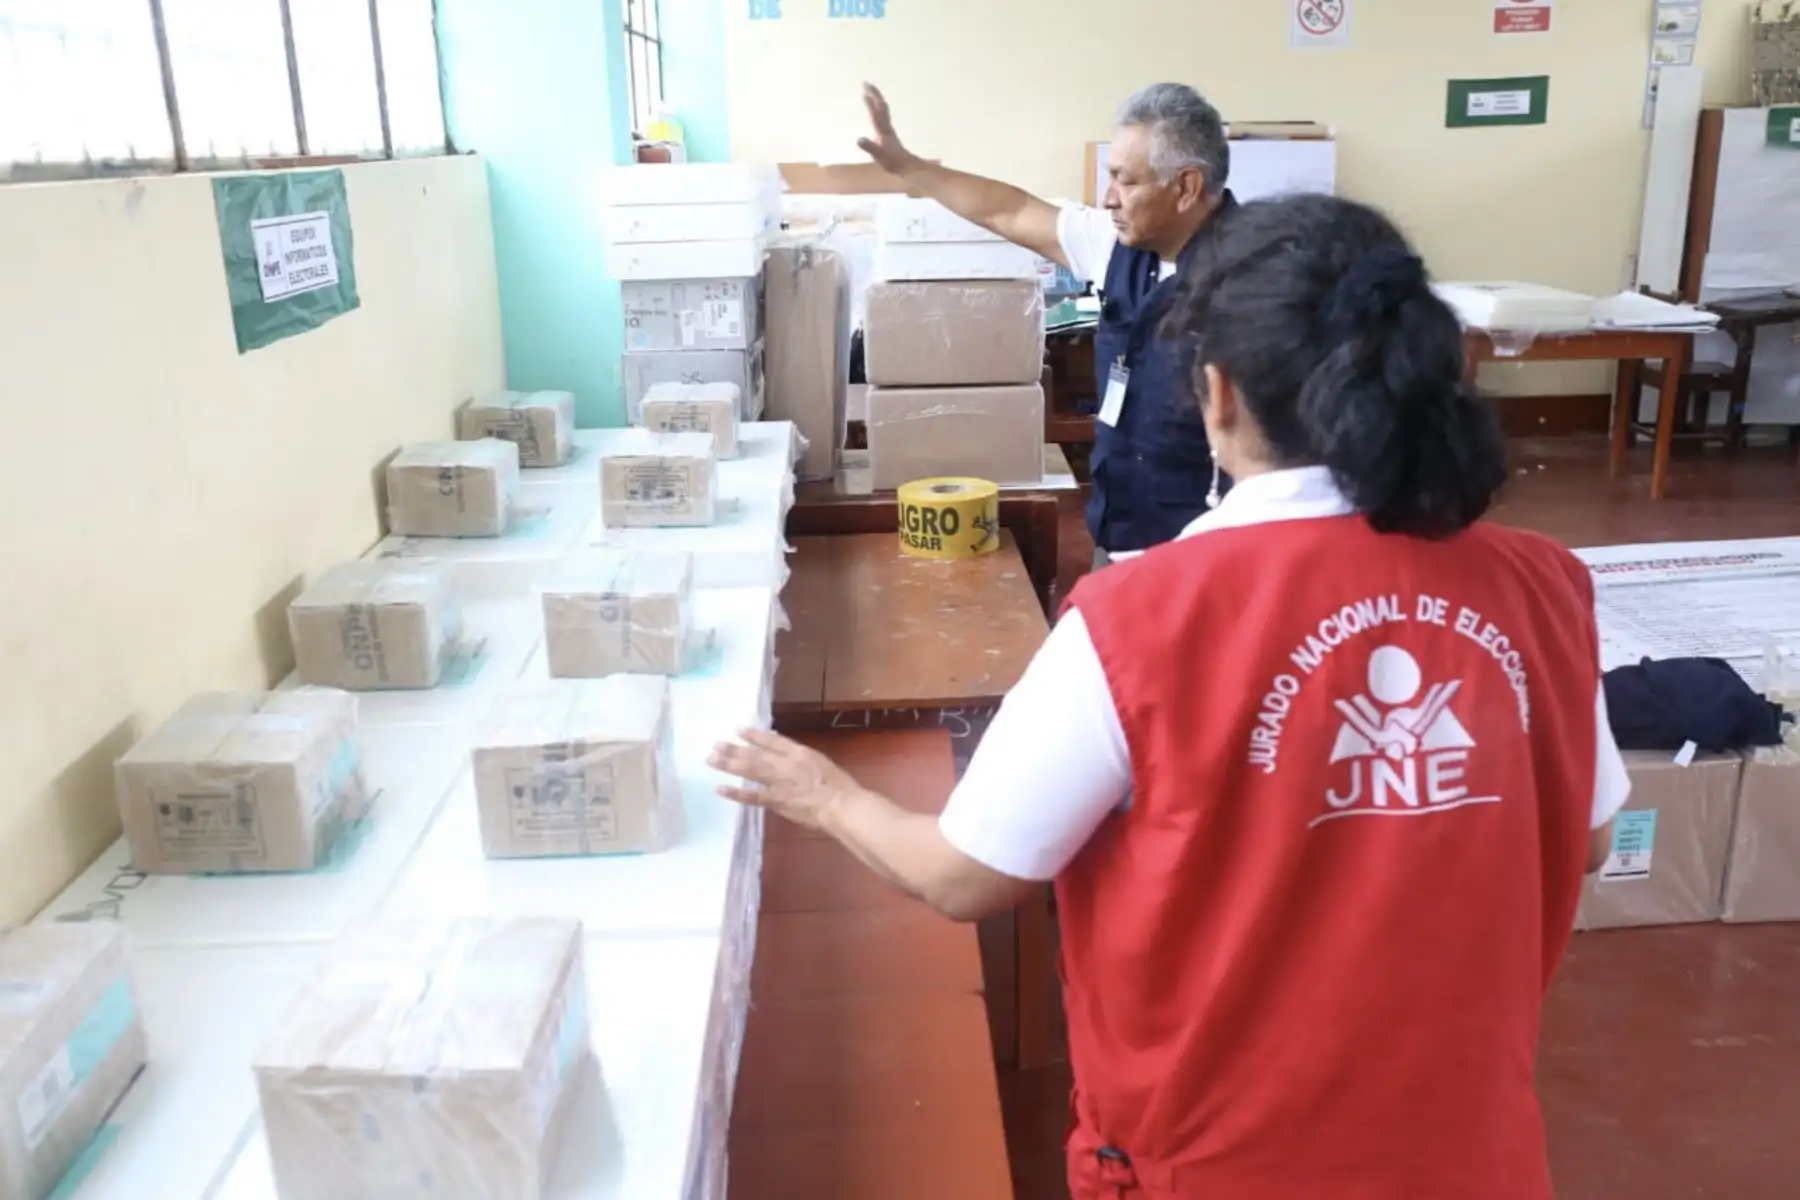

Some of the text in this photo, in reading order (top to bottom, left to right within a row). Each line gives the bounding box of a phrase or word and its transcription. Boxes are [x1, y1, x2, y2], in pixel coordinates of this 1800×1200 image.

[828, 0, 887, 19] DIOS
[288, 263, 330, 286] ELECTORALES
[899, 501, 960, 537] IGRO
[1248, 673, 1300, 774] JURADO
[1289, 593, 1407, 675] NACIONAL
[1415, 593, 1450, 627] DE
[1453, 605, 1530, 734] ELECCIO
[1325, 751, 1468, 808] JNE
